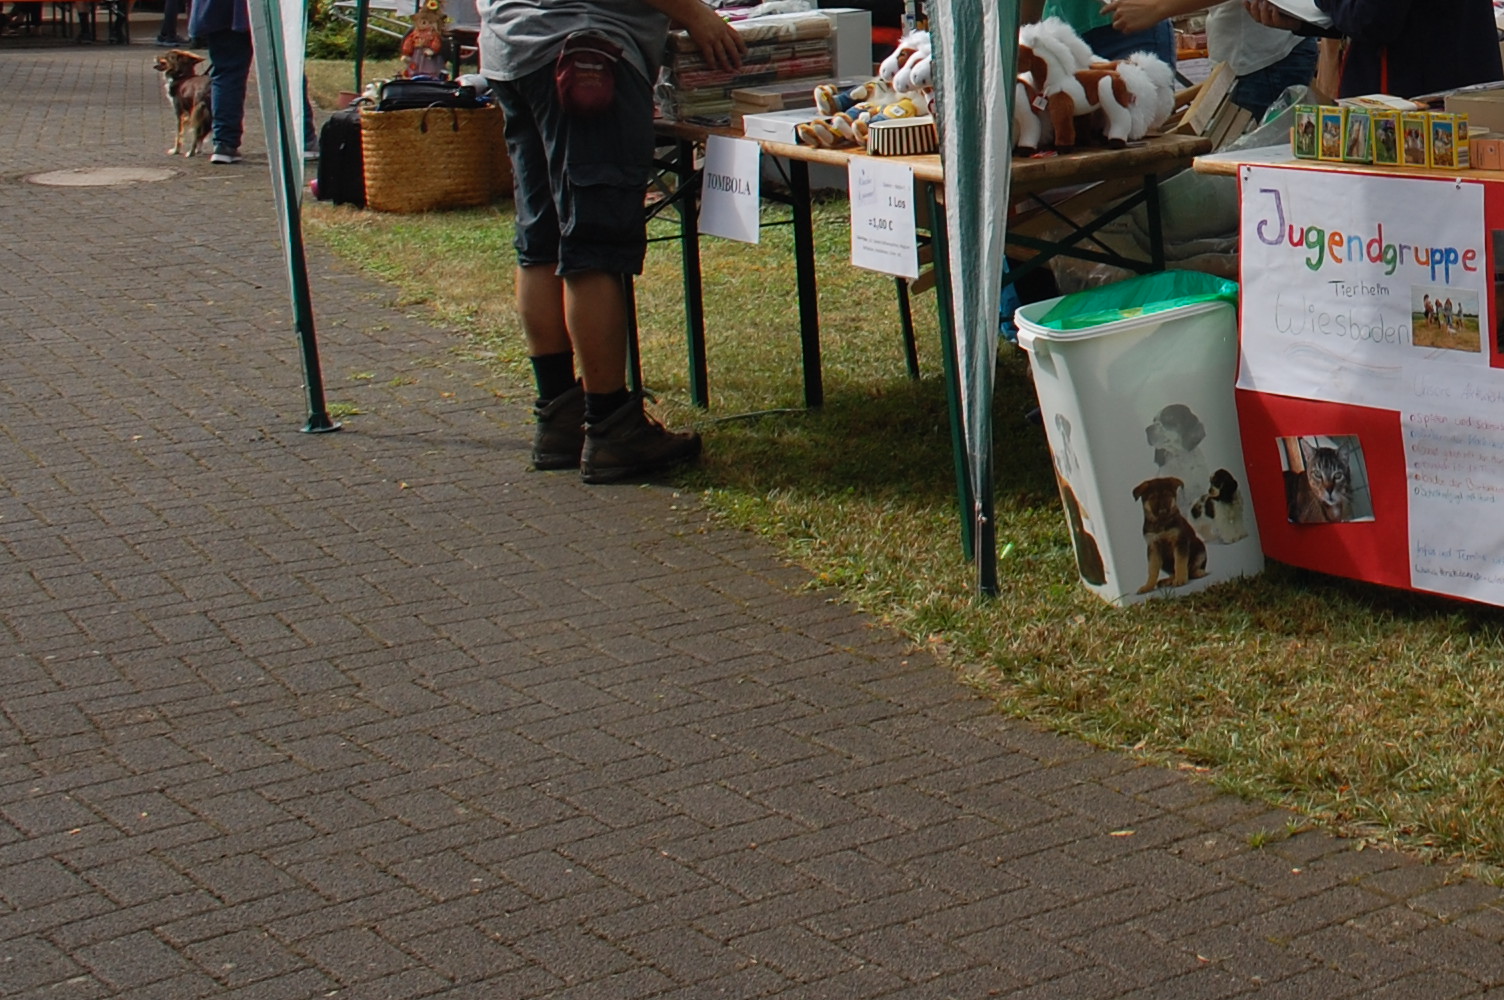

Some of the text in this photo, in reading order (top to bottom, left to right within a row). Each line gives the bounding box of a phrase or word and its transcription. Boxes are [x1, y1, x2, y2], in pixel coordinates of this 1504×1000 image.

[707, 172, 751, 195] TOMBOLA
[1256, 188, 1478, 284] Jugendgruppe
[1328, 280, 1390, 298] Tierheim
[1275, 292, 1410, 345] Wiesbaden
